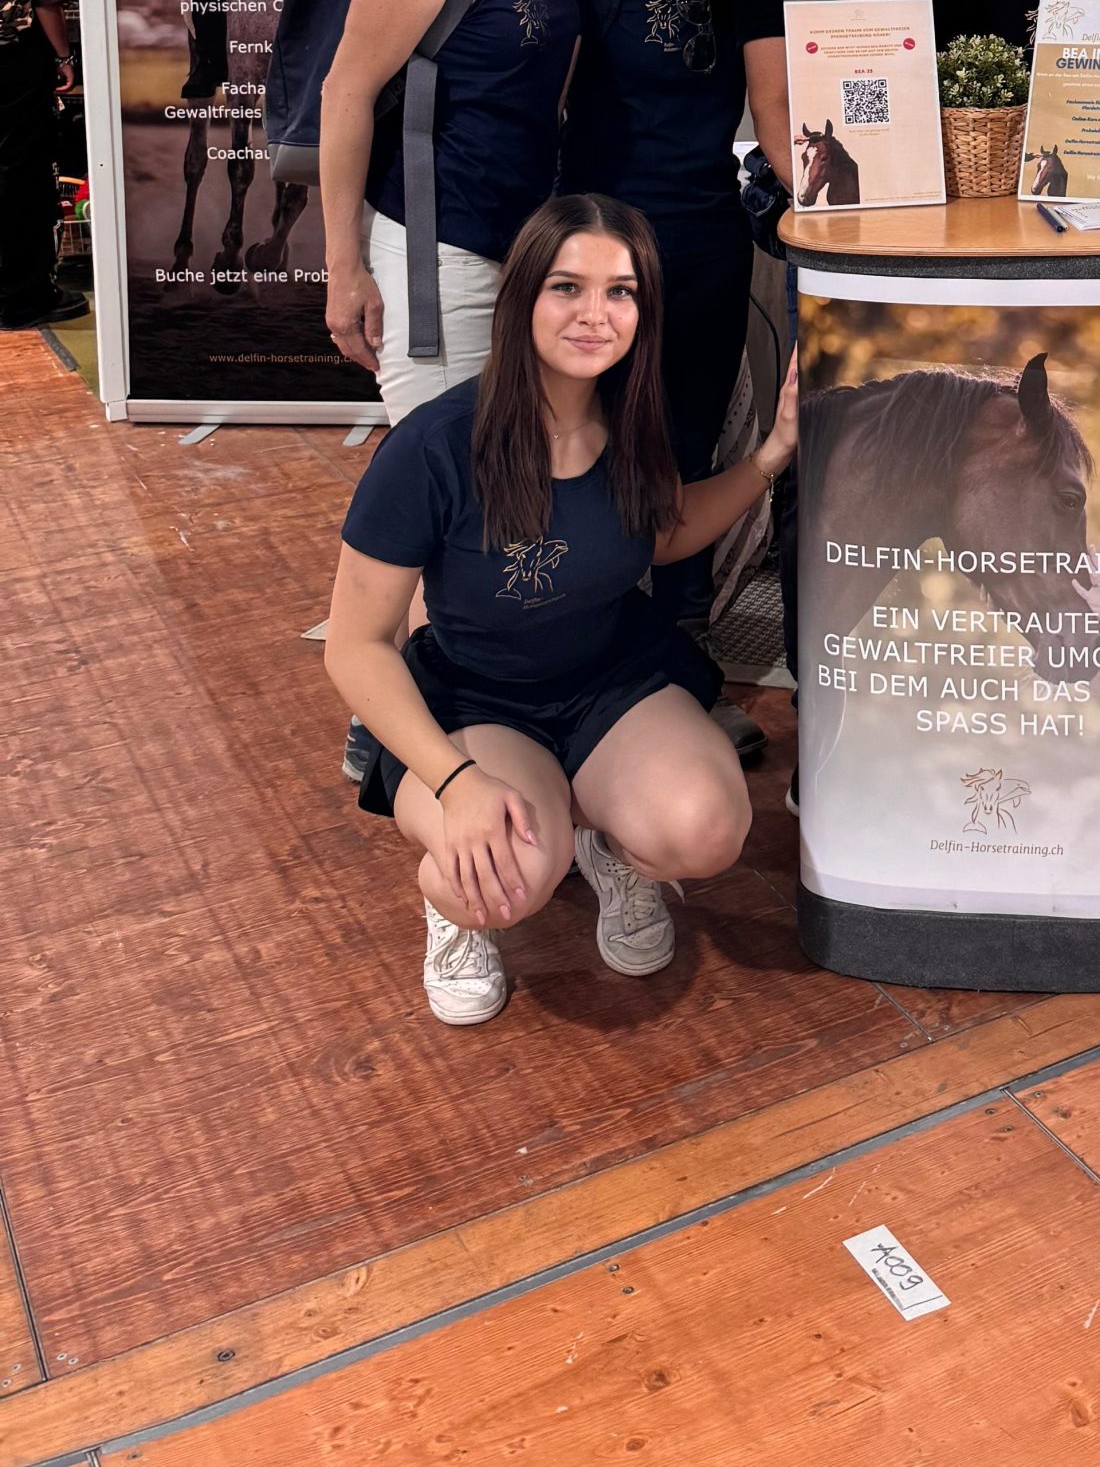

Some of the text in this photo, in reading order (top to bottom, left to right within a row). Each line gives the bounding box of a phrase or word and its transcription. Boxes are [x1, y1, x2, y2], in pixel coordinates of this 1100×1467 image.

[180, 0, 267, 14] physischen
[230, 40, 273, 53] Fernk
[1062, 47, 1089, 60] BEA
[164, 105, 262, 119] Gewaltfreies
[155, 268, 330, 286] Buche jetzt eine Prob
[872, 606, 919, 630] EIN
[823, 633, 1035, 667] GEWALTFREIER
[818, 664, 858, 692] BEI
[869, 672, 928, 698] DEM
[941, 677, 1019, 702] AUCH
[1032, 679, 1091, 703] DAS
[916, 709, 1085, 737] SPASS HAT!
[930, 838, 1065, 858] Delfin-Horsetraining.ch
[870, 1243, 924, 1291] A009
